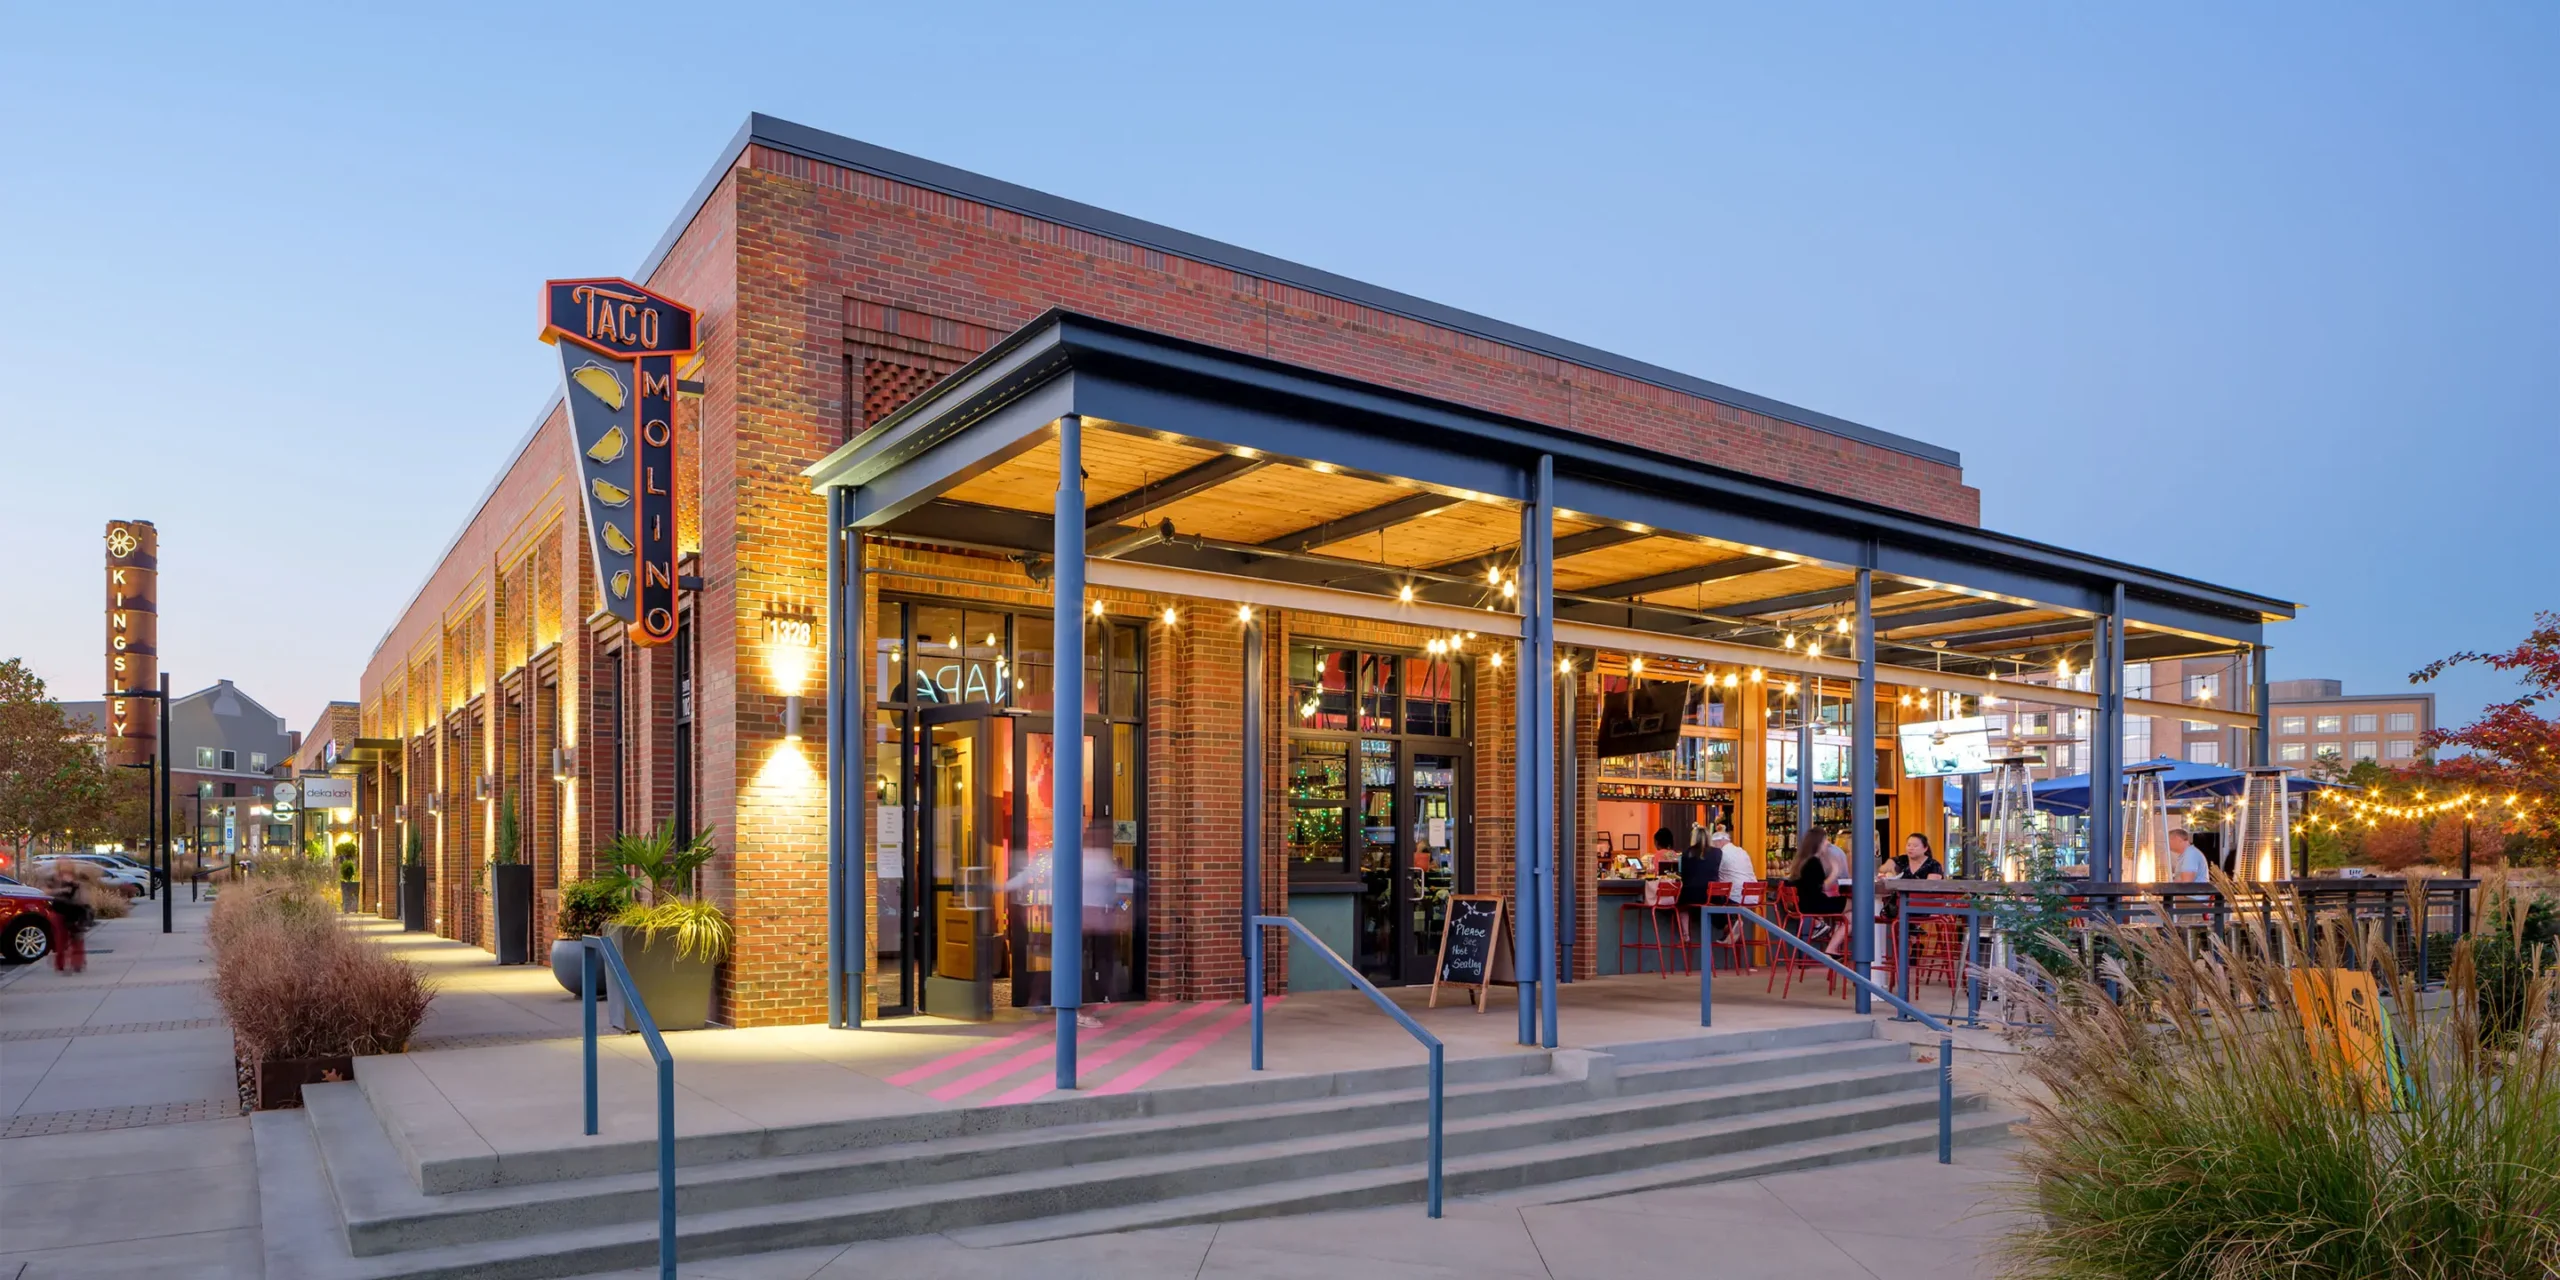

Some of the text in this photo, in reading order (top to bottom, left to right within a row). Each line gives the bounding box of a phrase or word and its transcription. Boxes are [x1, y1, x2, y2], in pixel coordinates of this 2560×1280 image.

[572, 285, 659, 349] TACO
[643, 371, 673, 635] MOLINO
[112, 570, 127, 737] KINGSLEY
[770, 620, 811, 646] 1328
[306, 789, 332, 798] deka
[333, 789, 351, 798] lash
[1452, 945, 1468, 955] Host
